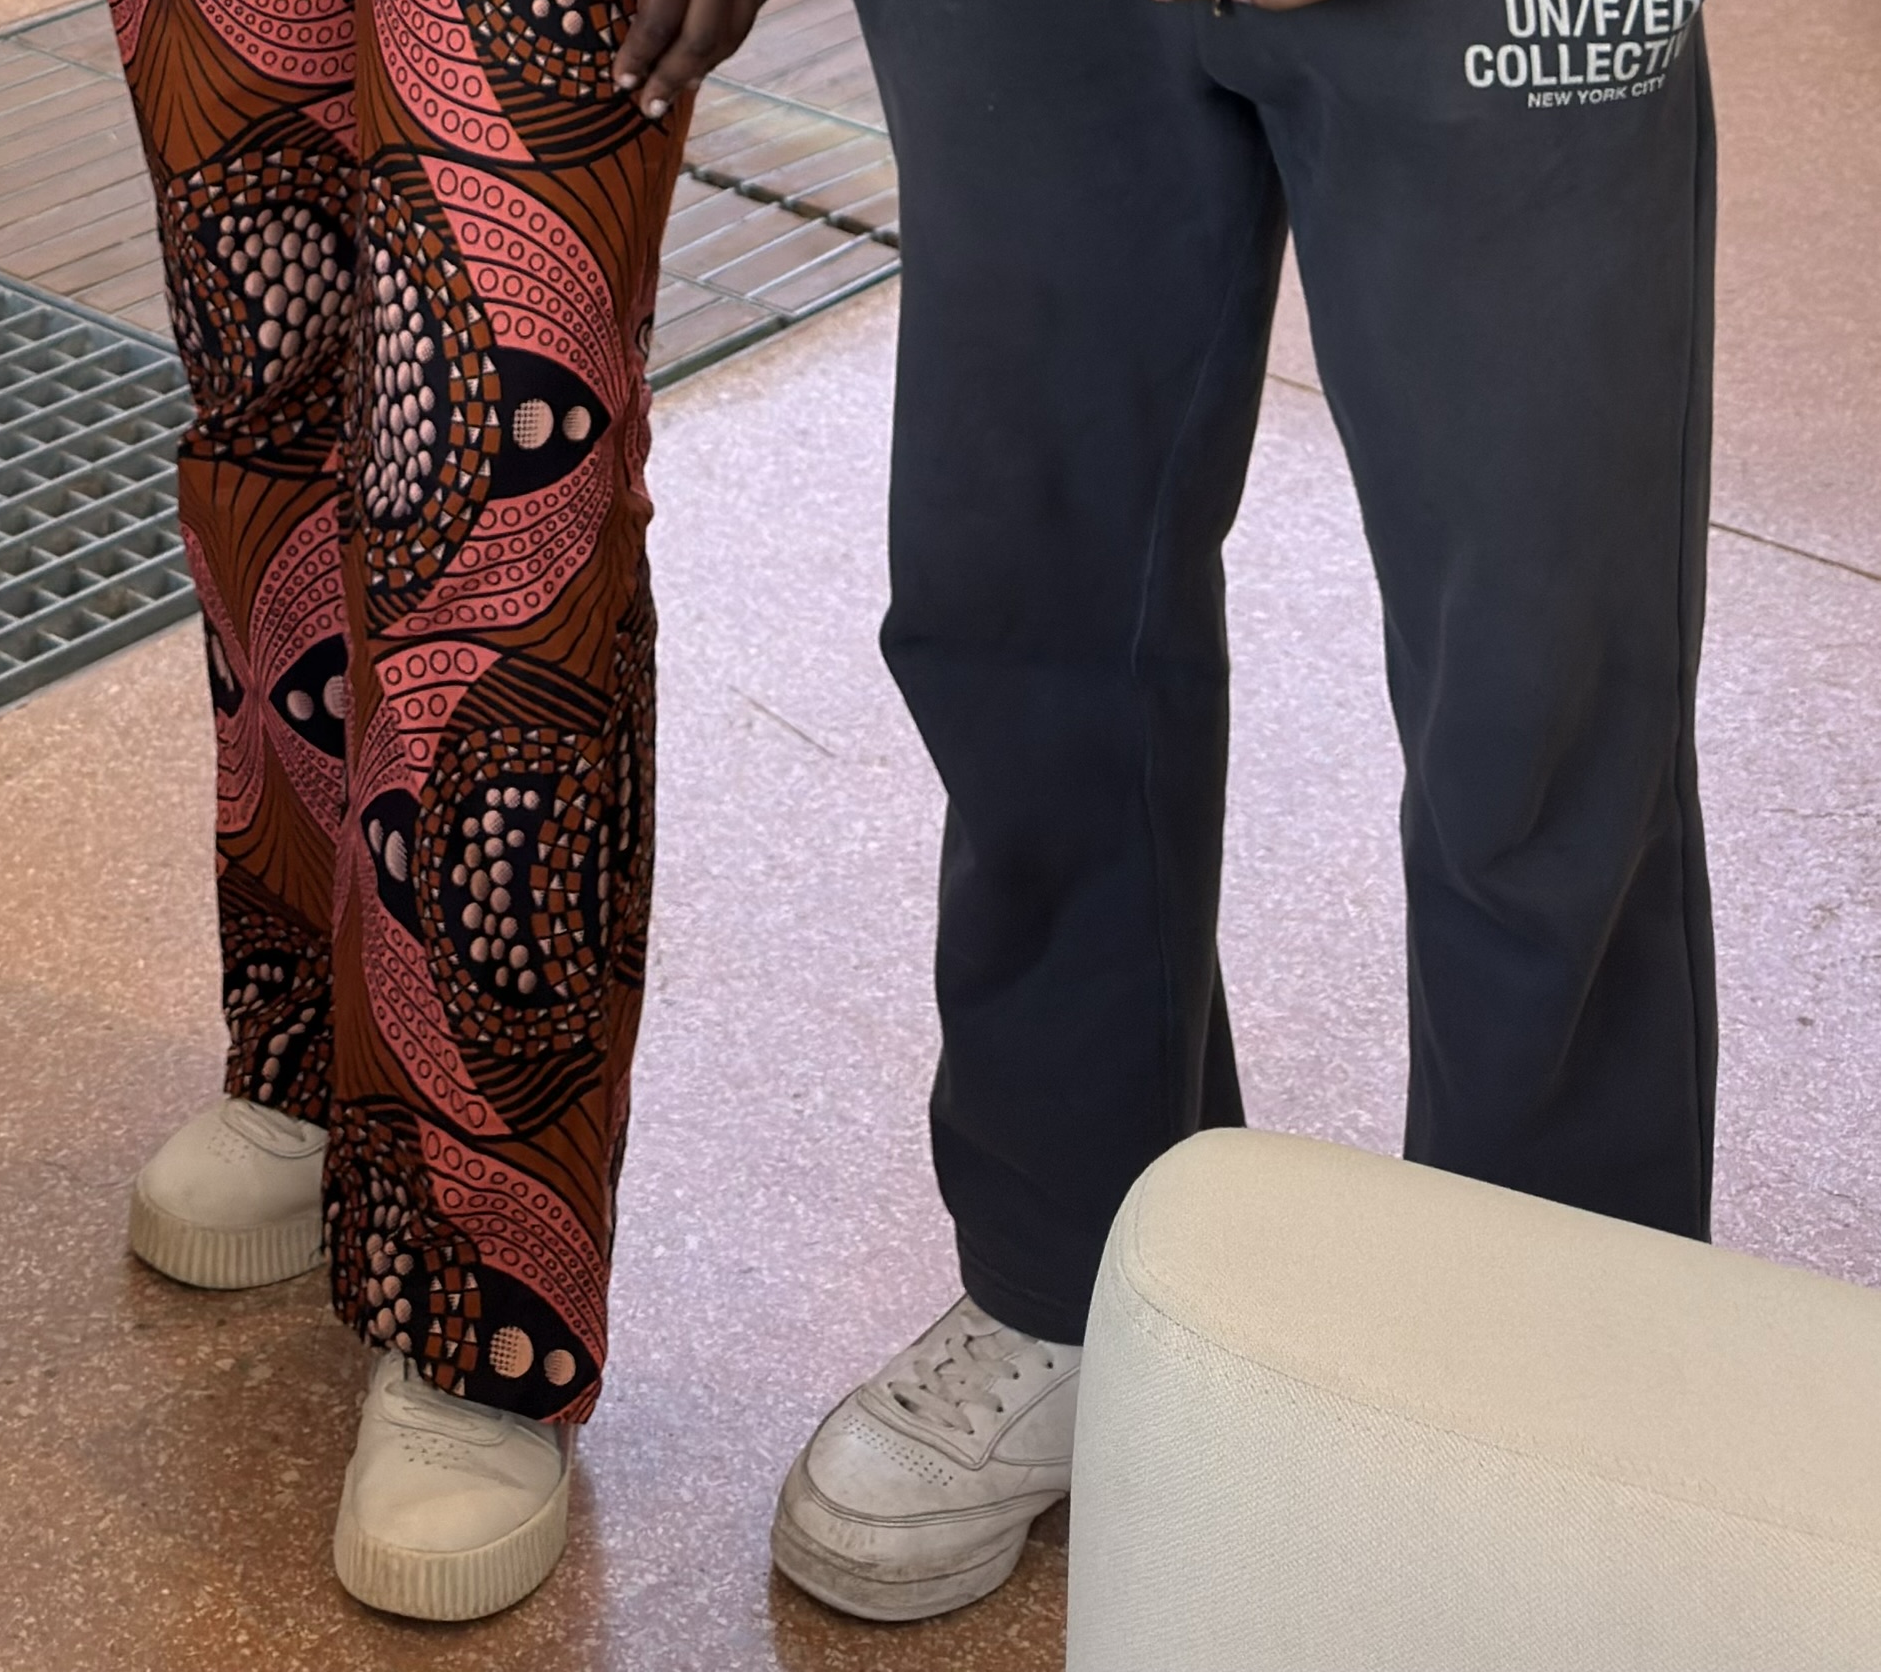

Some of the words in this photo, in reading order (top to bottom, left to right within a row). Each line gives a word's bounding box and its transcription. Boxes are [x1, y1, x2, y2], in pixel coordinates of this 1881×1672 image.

[1527, 90, 1573, 109] NEW
[1577, 84, 1627, 105] YORK
[1630, 73, 1667, 98] CITY
